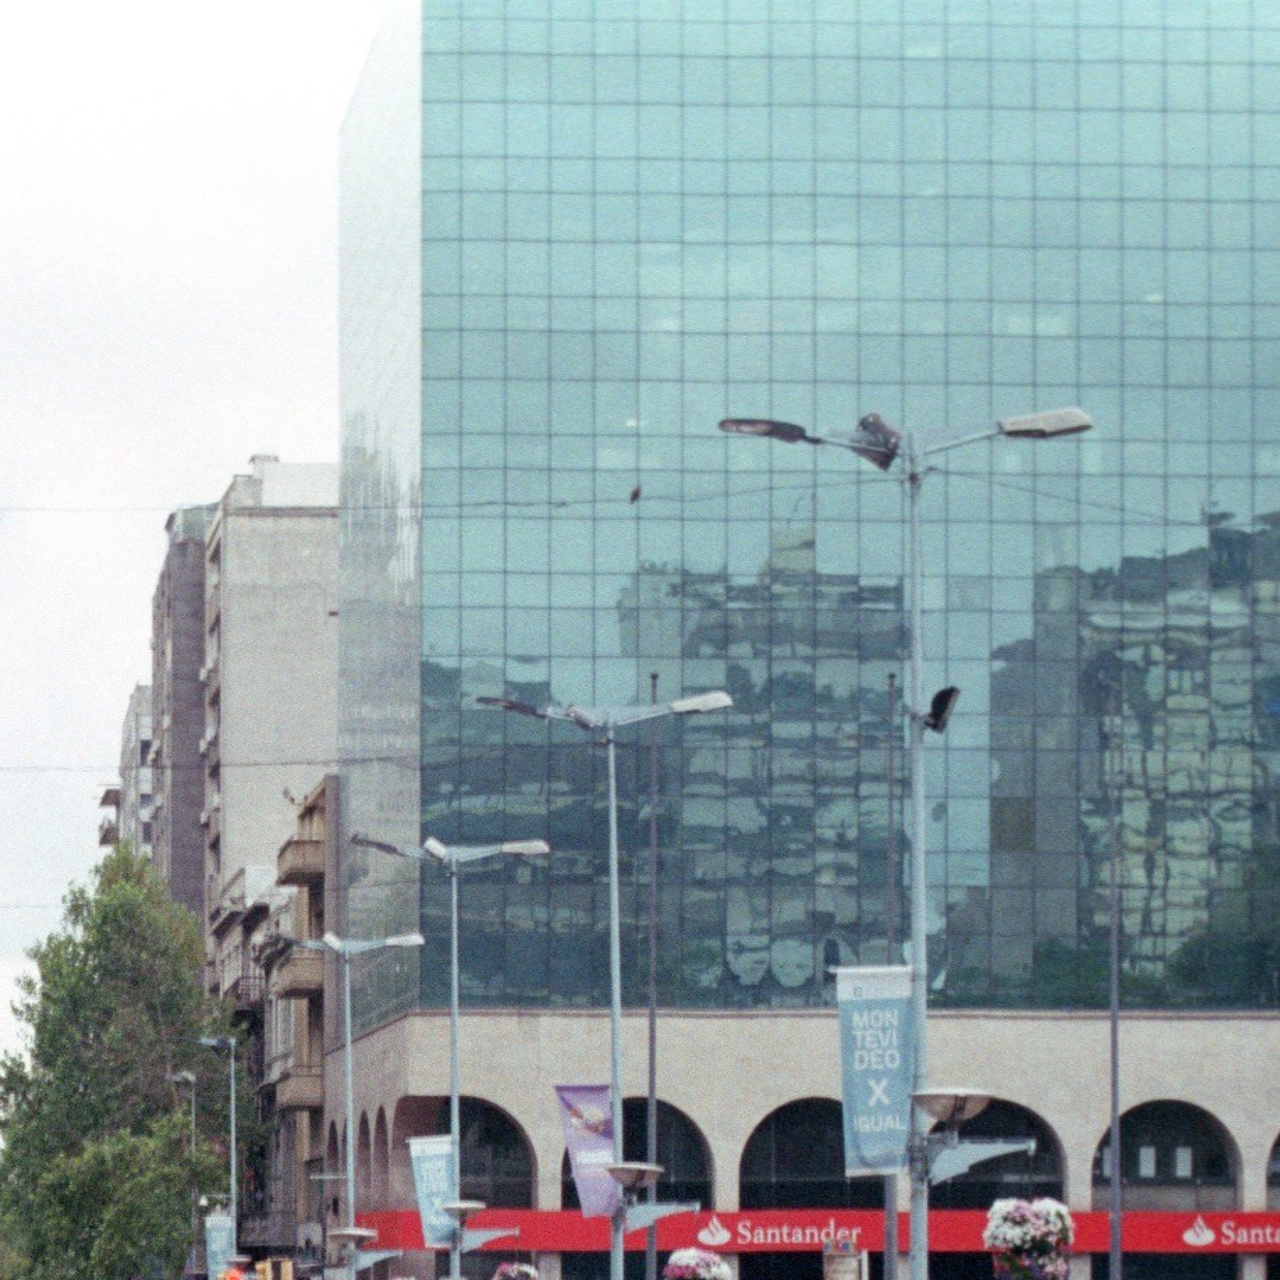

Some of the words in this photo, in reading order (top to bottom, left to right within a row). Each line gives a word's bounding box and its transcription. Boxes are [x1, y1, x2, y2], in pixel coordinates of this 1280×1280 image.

[851, 1010, 899, 1028] MON
[851, 1029, 898, 1049] TEVI
[854, 1051, 901, 1071] DEO
[868, 1078, 890, 1106] X
[854, 1114, 908, 1133] IGUAL
[737, 1217, 862, 1245] Santander
